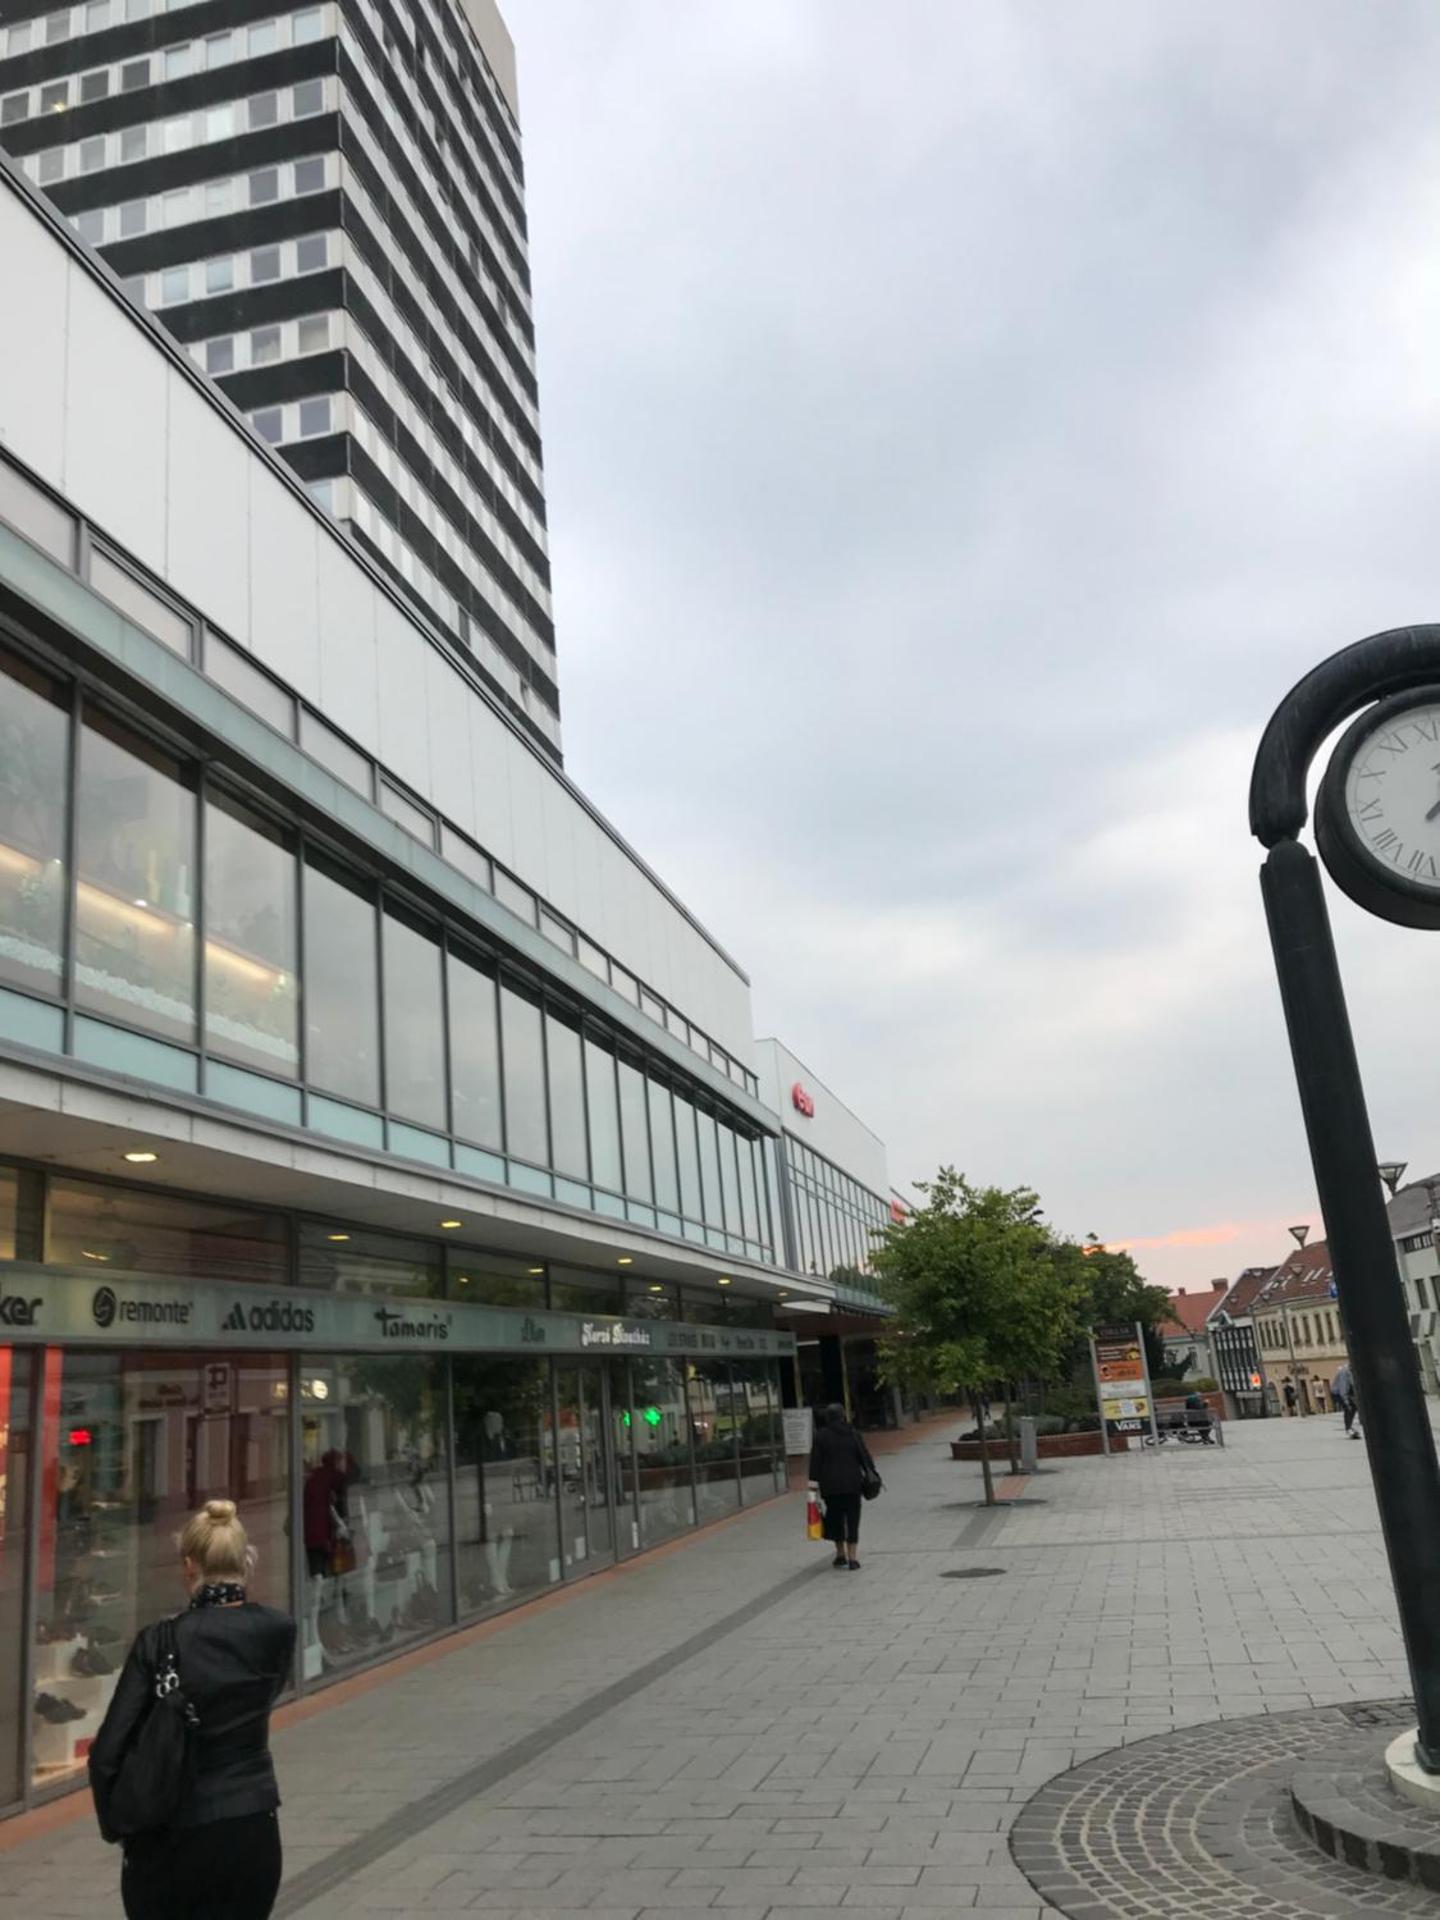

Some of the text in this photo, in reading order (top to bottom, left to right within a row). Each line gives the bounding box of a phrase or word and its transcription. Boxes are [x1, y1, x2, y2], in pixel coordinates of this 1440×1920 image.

[119, 1299, 190, 1324] remonte
[249, 1301, 314, 1333] adidas
[374, 1307, 448, 1339] Tamaris
